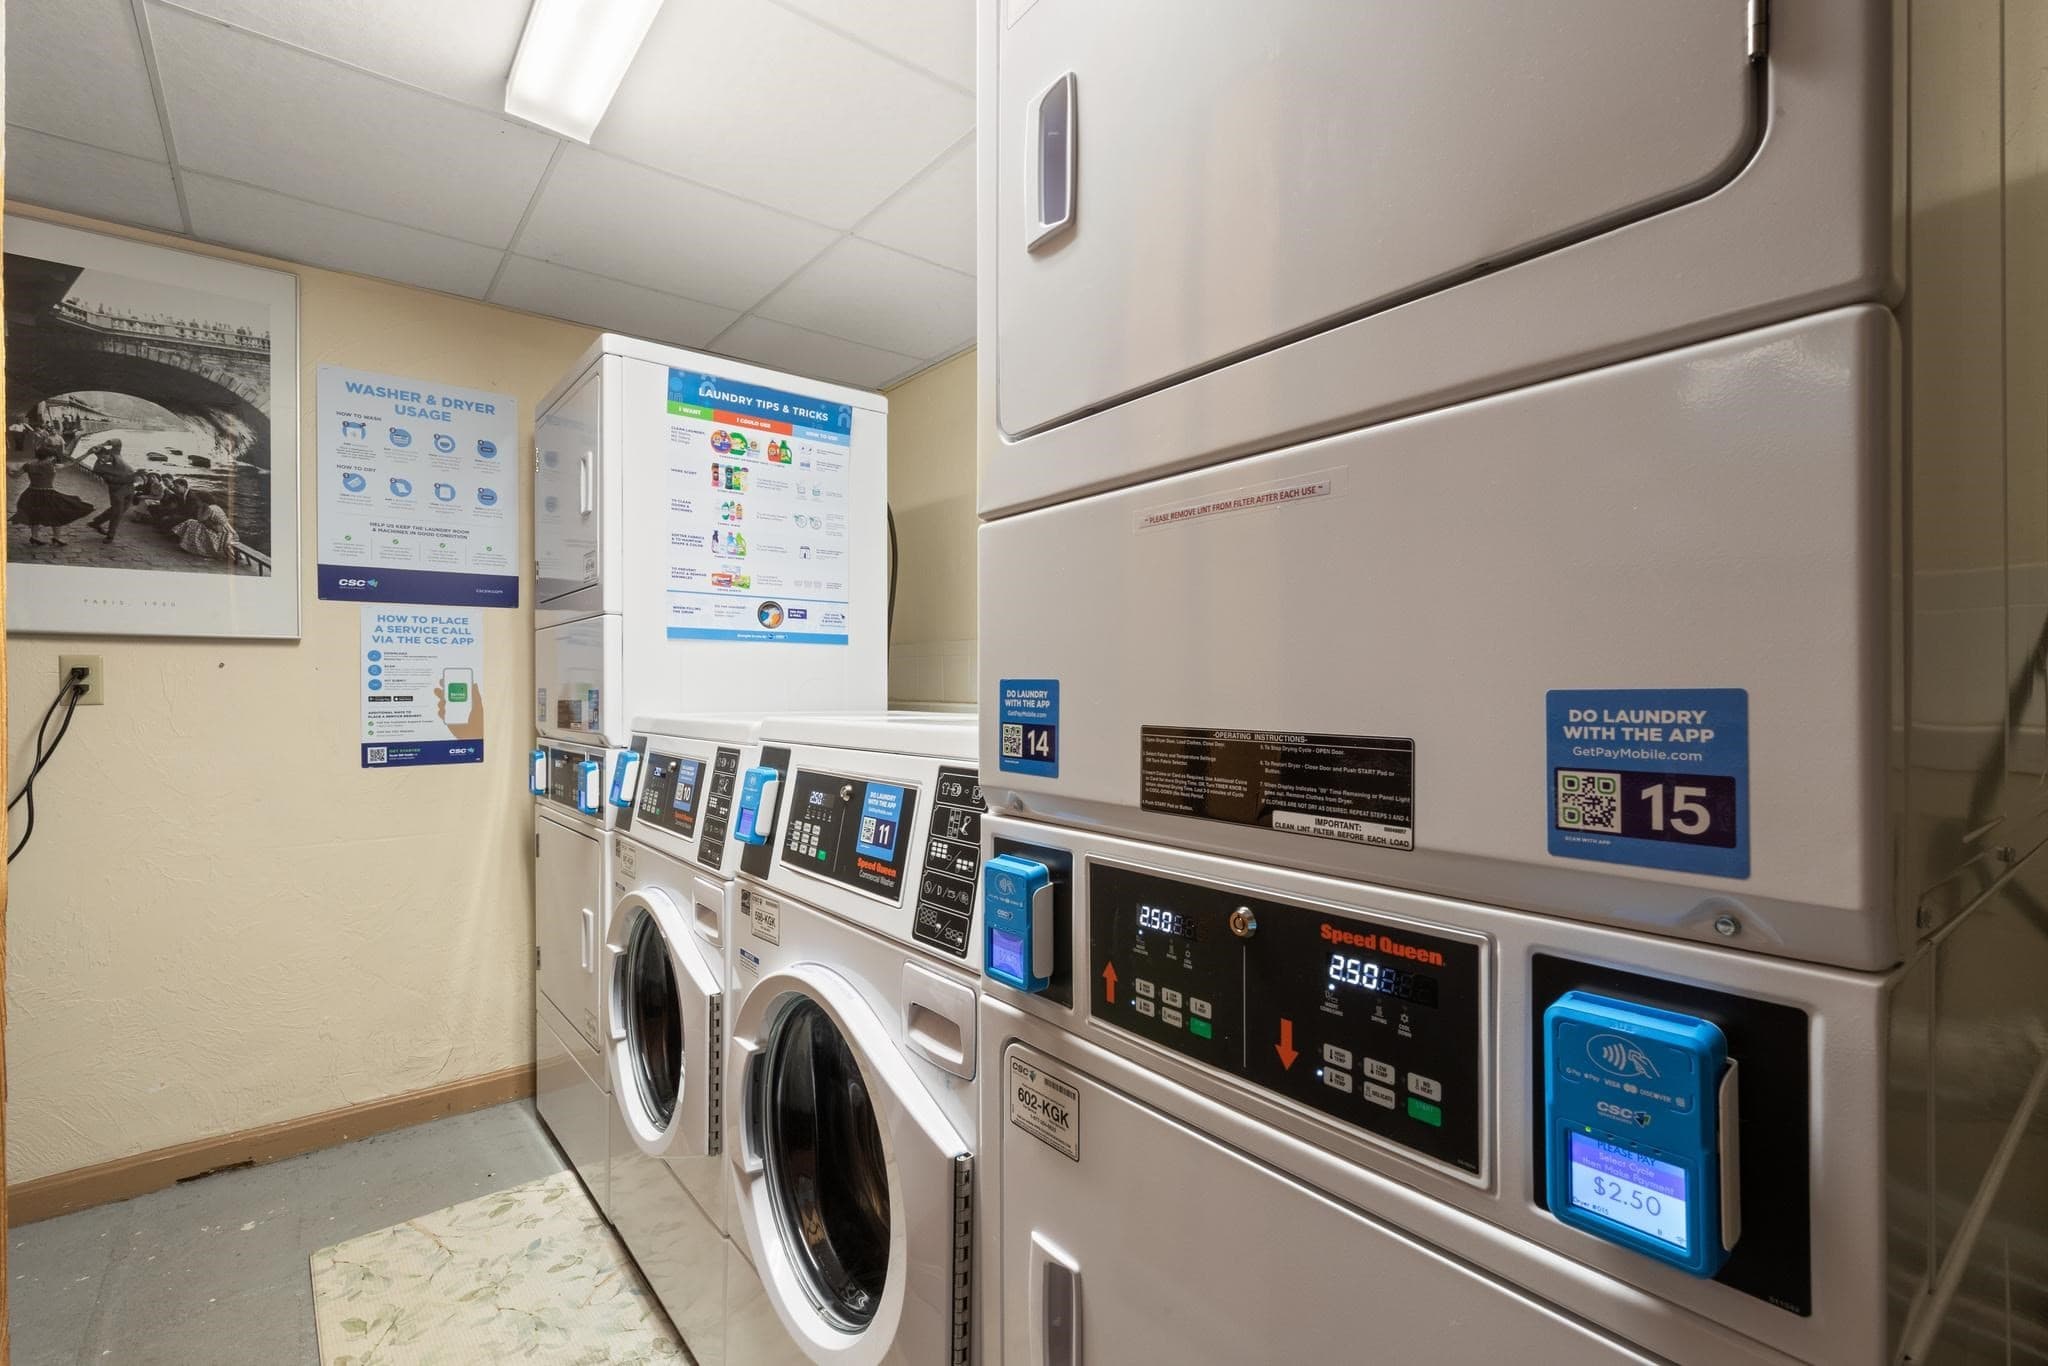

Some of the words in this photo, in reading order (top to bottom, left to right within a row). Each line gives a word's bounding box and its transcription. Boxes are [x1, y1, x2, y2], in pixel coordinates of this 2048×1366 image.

[346, 381, 421, 402] WASHER
[426, 395, 436, 405] &
[442, 397, 495, 415] DRYER
[699, 388, 753, 404] LAUNDRY
[756, 400, 779, 412] TIPS
[783, 405, 789, 413] &
[792, 407, 828, 421] TRICKS
[395, 405, 451, 421] USAGE
[740, 418, 759, 426] COULD
[1150, 515, 1169, 524] PLEASE
[1171, 508, 1196, 520] REMOVE
[1197, 506, 1211, 515] LINT
[1212, 501, 1232, 511] FROM
[1233, 497, 1255, 508] FILTER
[1256, 493, 1278, 504] AFTER
[1279, 488, 1300, 500] EACH
[1301, 485, 1316, 496] USE
[339, 579, 366, 587] CSC
[377, 615, 407, 623] HOW
[412, 616, 428, 624] TO
[431, 617, 468, 625] PLACE
[387, 626, 439, 634] SERVICE
[442, 627, 471, 635] CALL
[397, 636, 421, 644] THE
[425, 636, 447, 644] CSC
[451, 637, 474, 645] APP
[1017, 690, 1048, 698] LAUNDRY
[1005, 699, 1021, 707] WITH
[1569, 709, 1597, 722] DO
[1603, 710, 1707, 724] LAUNDRY
[1563, 726, 1615, 740] WITH
[1621, 727, 1663, 742] THE
[1669, 728, 1715, 743] APP
[1028, 730, 1049, 756] 14
[1572, 746, 1702, 761] GetPayMobile.com
[877, 793, 896, 801] LAUNDRY
[1641, 783, 1711, 836] 15
[1315, 818, 1362, 831] IMPORTANT:
[879, 824, 890, 844] 11
[1275, 822, 1295, 830] CLEAN
[1297, 825, 1311, 833] LINT
[1313, 827, 1334, 836] FILTER
[1337, 830, 1364, 841] BEFORE
[1367, 835, 1386, 844] EACH
[1390, 839, 1409, 847] LOAD
[858, 857, 875, 870] Speed
[877, 862, 896, 877] Queen
[1320, 923, 1376, 950] Speed
[1380, 936, 1443, 966] Queen
[1330, 954, 1379, 989] 2.50
[1012, 1062, 1028, 1076] CSC
[1375, 1070, 1388, 1078] TEMP
[1334, 1079, 1346, 1087] TEMP
[1420, 1087, 1433, 1095] HEAT
[1605, 1078, 1621, 1088] VISA
[1018, 1087, 1069, 1128] 602-KGK
[1597, 1101, 1632, 1118] CSC
[1597, 1141, 1632, 1159] PLEASE
[1637, 1153, 1655, 1166] PAY
[1599, 1152, 1626, 1167] Select
[1629, 1162, 1654, 1178] Cycle
[1604, 1164, 1629, 1179] Make
[1633, 1174, 1674, 1194] Payment
[1593, 1176, 1660, 1216] $2.50
